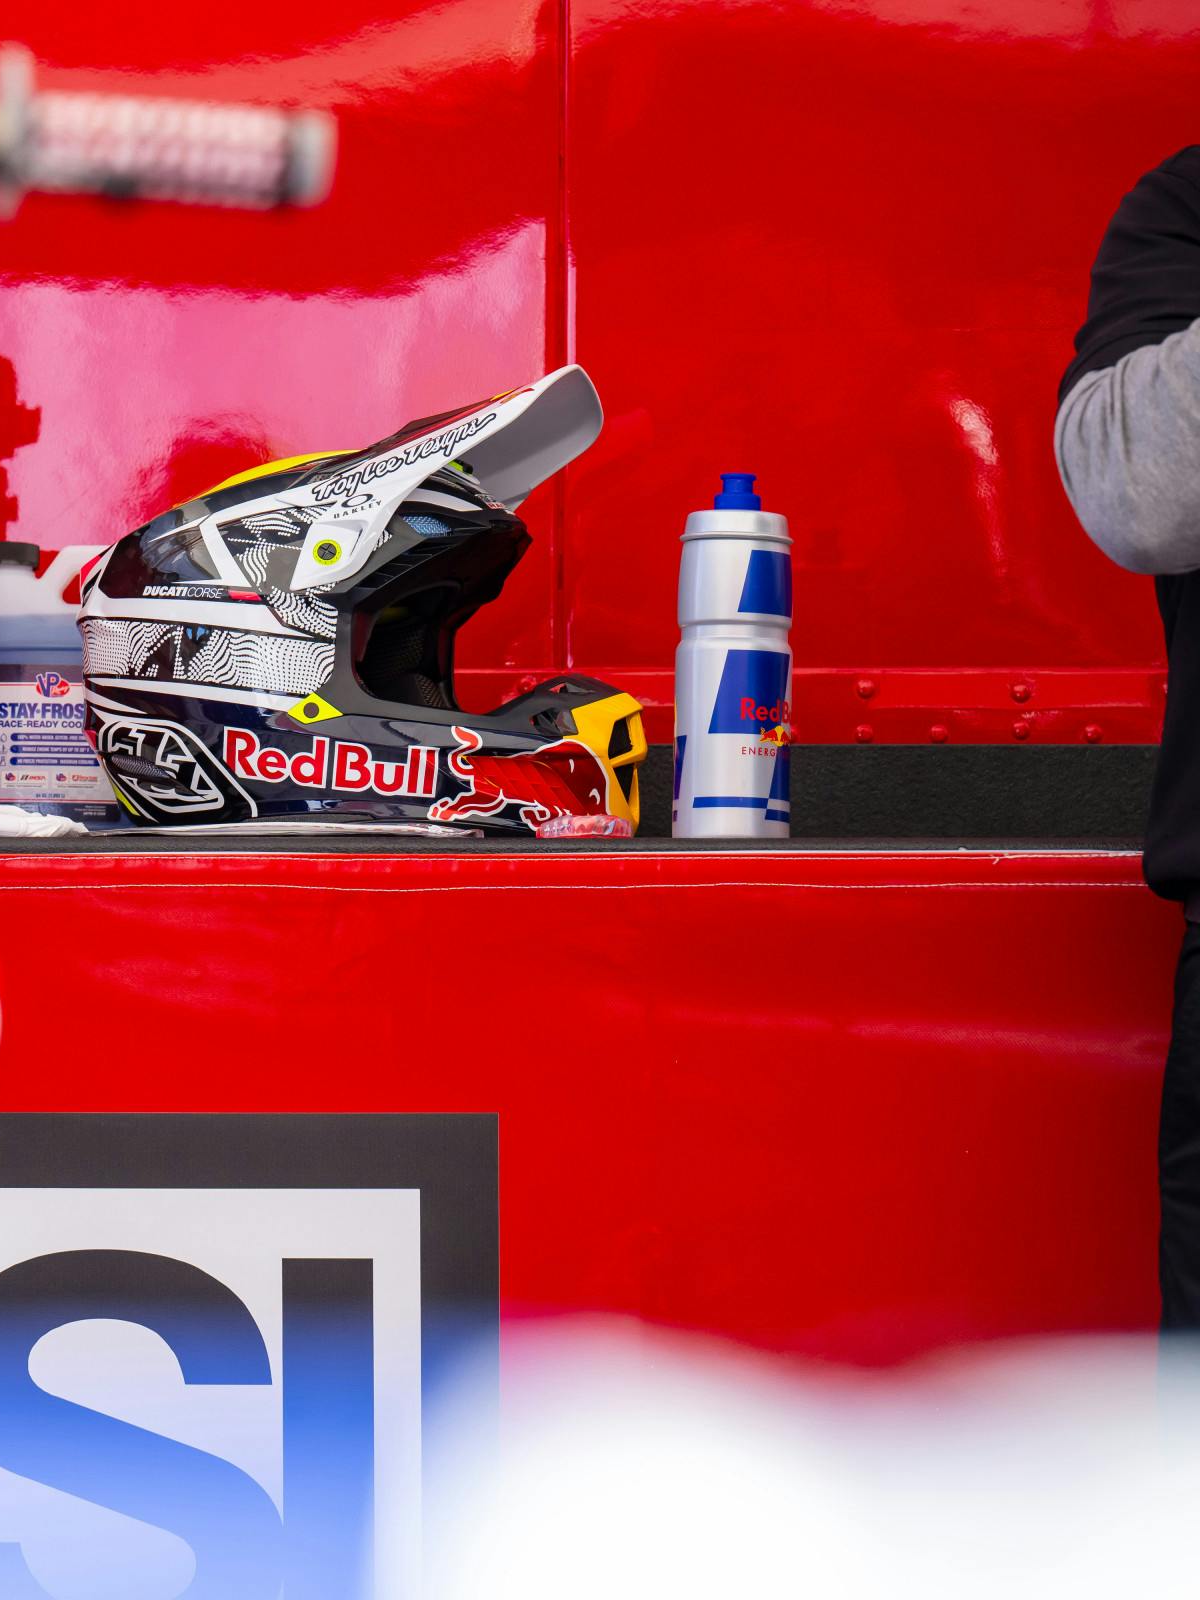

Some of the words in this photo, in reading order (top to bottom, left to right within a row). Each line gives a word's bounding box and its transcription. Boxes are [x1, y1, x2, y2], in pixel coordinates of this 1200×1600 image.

[312, 469, 361, 501] Troy
[361, 456, 404, 484] Lee
[142, 585, 189, 597] DUCATI
[187, 586, 224, 599] CORSE
[740, 697, 781, 723] Red
[224, 727, 329, 788] Red
[332, 741, 440, 797] Bull
